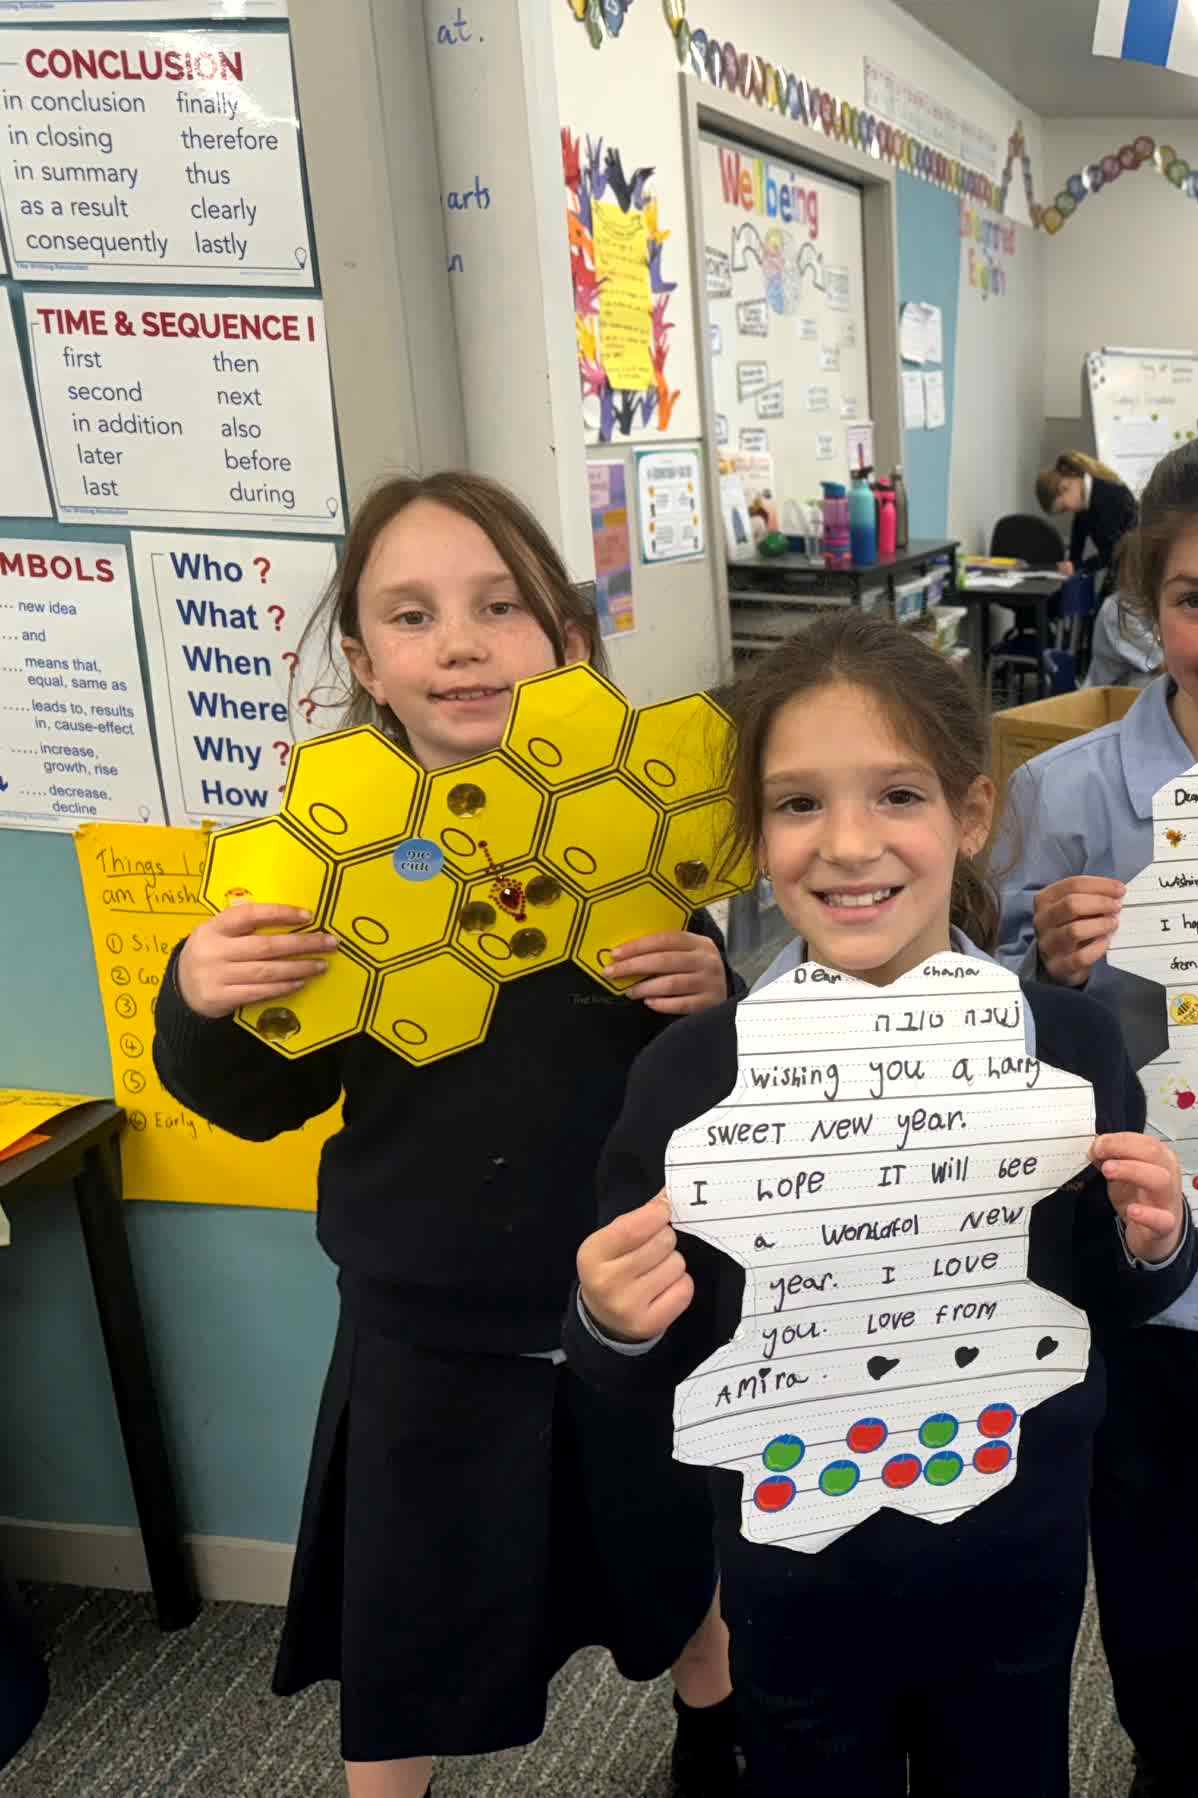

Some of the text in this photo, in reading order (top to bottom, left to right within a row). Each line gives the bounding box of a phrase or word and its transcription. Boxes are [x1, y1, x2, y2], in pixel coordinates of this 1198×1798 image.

[25, 48, 244, 81] CONCLUSION
[2, 89, 145, 113] in conclusion
[176, 91, 238, 120] finally
[9, 124, 113, 153] in closing
[181, 127, 279, 151] therefore
[14, 160, 138, 189] in summary
[185, 162, 231, 185] thus
[20, 195, 129, 218] as a result
[190, 197, 257, 227] clearly
[26, 232, 168, 259] consequently
[194, 231, 248, 260] lastly
[37, 308, 316, 342] TIME & SEQUENCE I
[63, 346, 103, 369] first
[212, 351, 259, 373] then
[67, 381, 143, 402] second
[216, 388, 263, 406] next
[72, 413, 183, 436] in addition
[221, 417, 262, 439] also
[78, 443, 122, 465] later
[224, 448, 292, 472] before
[82, 476, 119, 497] last
[230, 481, 296, 510] during
[170, 551, 243, 583] Who
[18, 602, 77, 616] new idea
[175, 598, 259, 630] What
[21, 629, 47, 642] and
[25, 658, 70, 671] means
[181, 644, 272, 676] When
[28, 675, 128, 692] equal, same as
[32, 699, 135, 718] leads to, results
[187, 690, 288, 723] Where
[35, 717, 136, 735] in, cause-effect
[40, 743, 99, 758] increase,
[193, 735, 262, 771] Why
[43, 759, 119, 776] growth, rise
[201, 779, 268, 808] How
[52, 801, 97, 816] decline
[96, 847, 165, 888] Things
[103, 888, 136, 906] am
[1160, 919, 1170, 932] I
[870, 1059, 925, 1100] you
[953, 1058, 973, 1080] a
[898, 1108, 967, 1151] year.
[690, 1180, 708, 1207] I
[757, 1169, 826, 1202] hope
[931, 1156, 969, 1184] will
[755, 1235, 775, 1250] a
[770, 1272, 840, 1312] year.
[882, 1266, 895, 1284] I
[762, 1321, 826, 1359] you.
[936, 1301, 998, 1325] from
